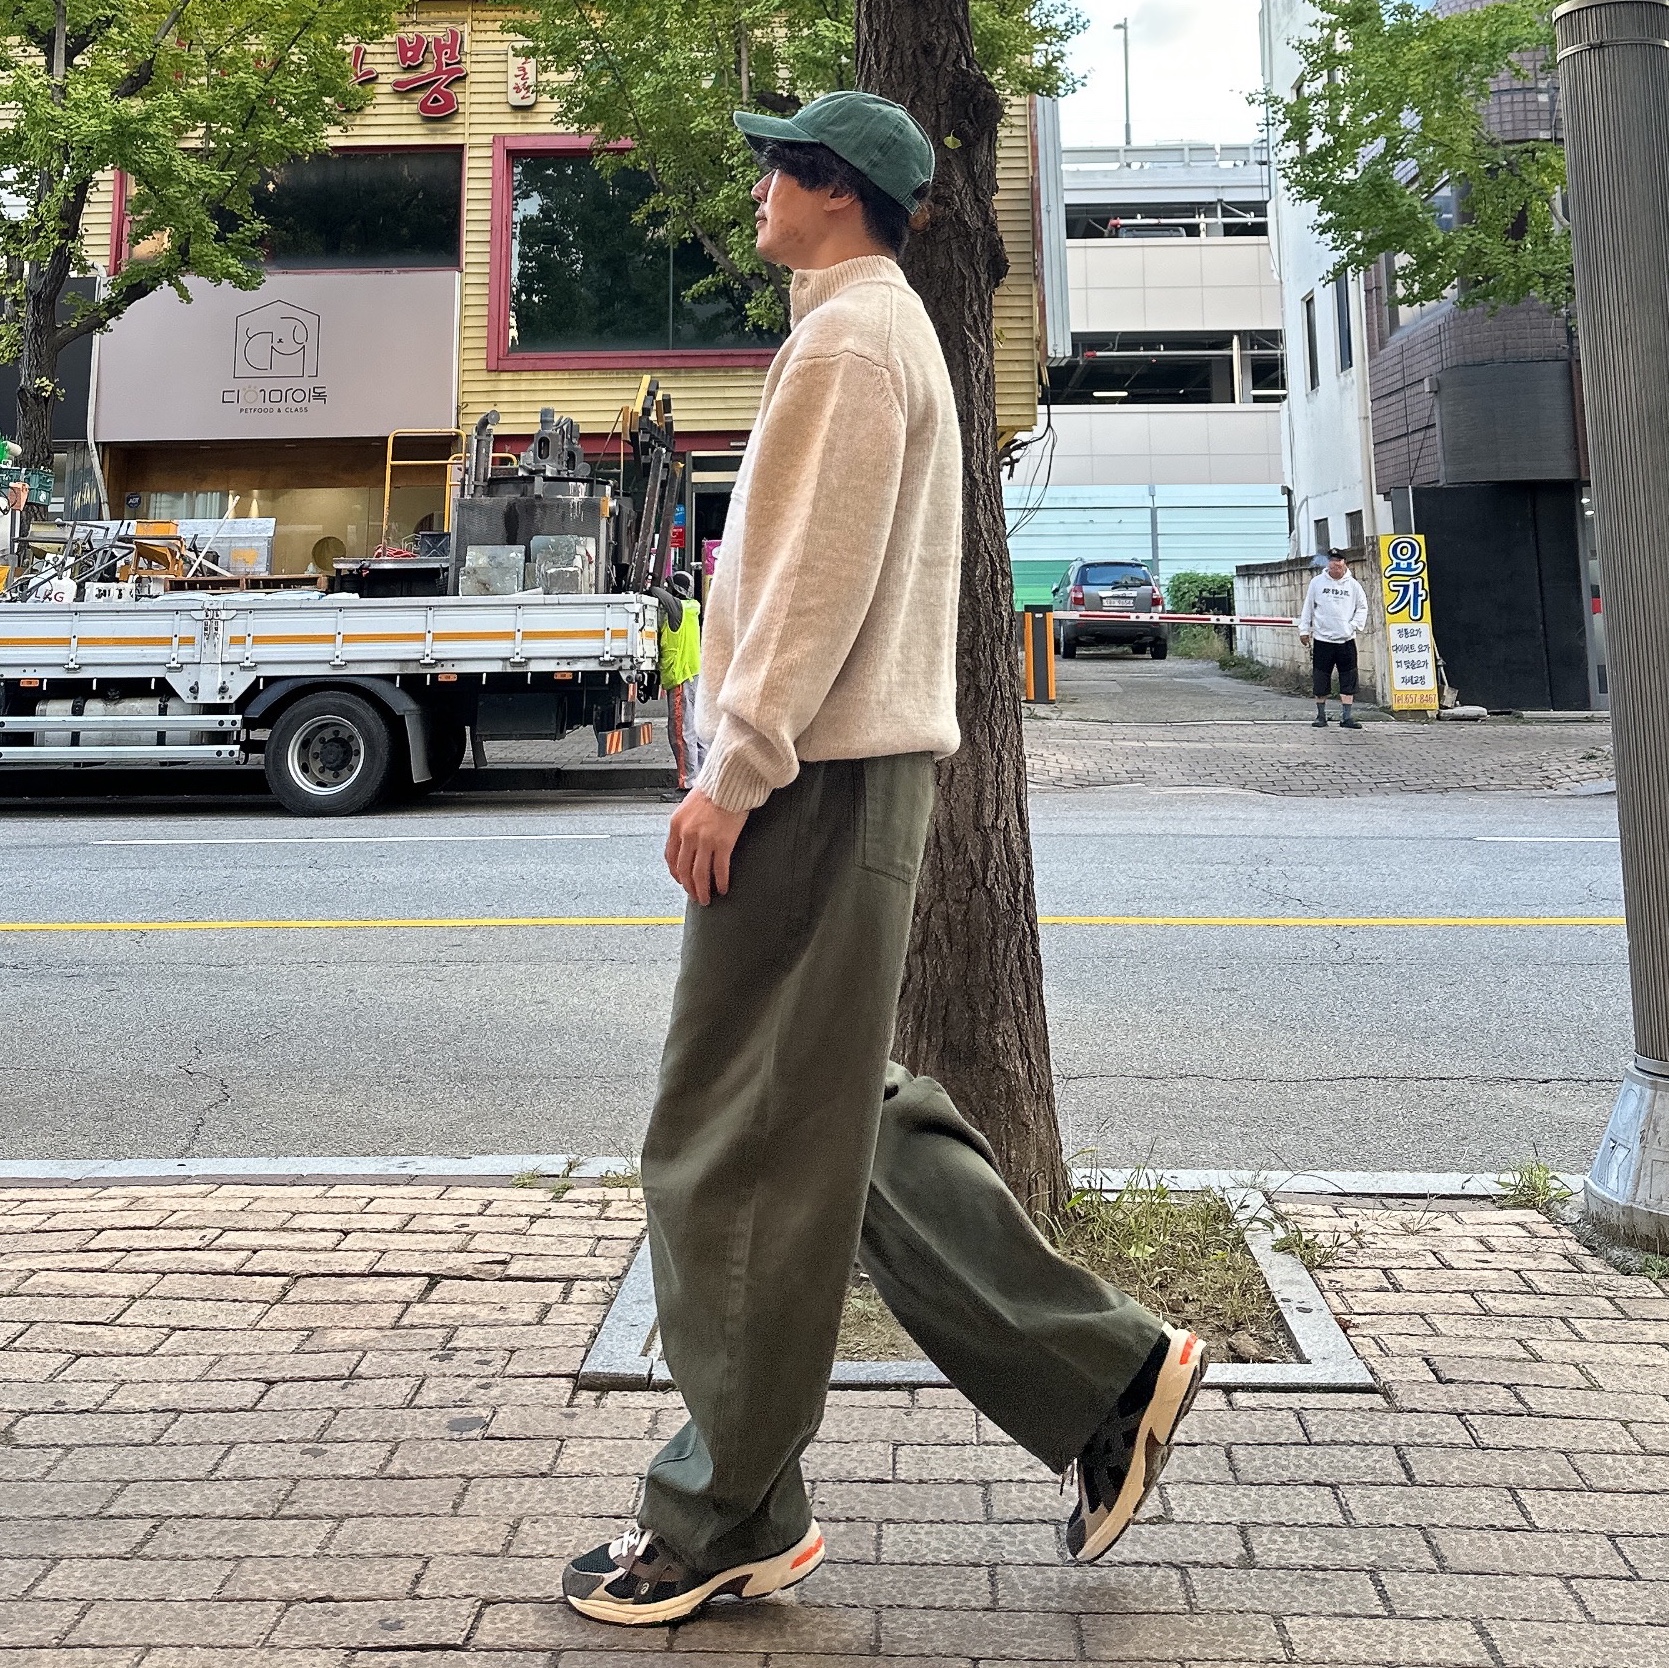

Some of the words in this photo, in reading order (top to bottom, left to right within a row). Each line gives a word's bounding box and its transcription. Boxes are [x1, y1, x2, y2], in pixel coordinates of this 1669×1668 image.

[1384, 536, 1428, 621] 요가
[1397, 628, 1422, 638] 정통요가
[1392, 644, 1416, 653] 다이어트
[1417, 644, 1430, 653] 요가
[1401, 675, 1426, 685] 자세교정
